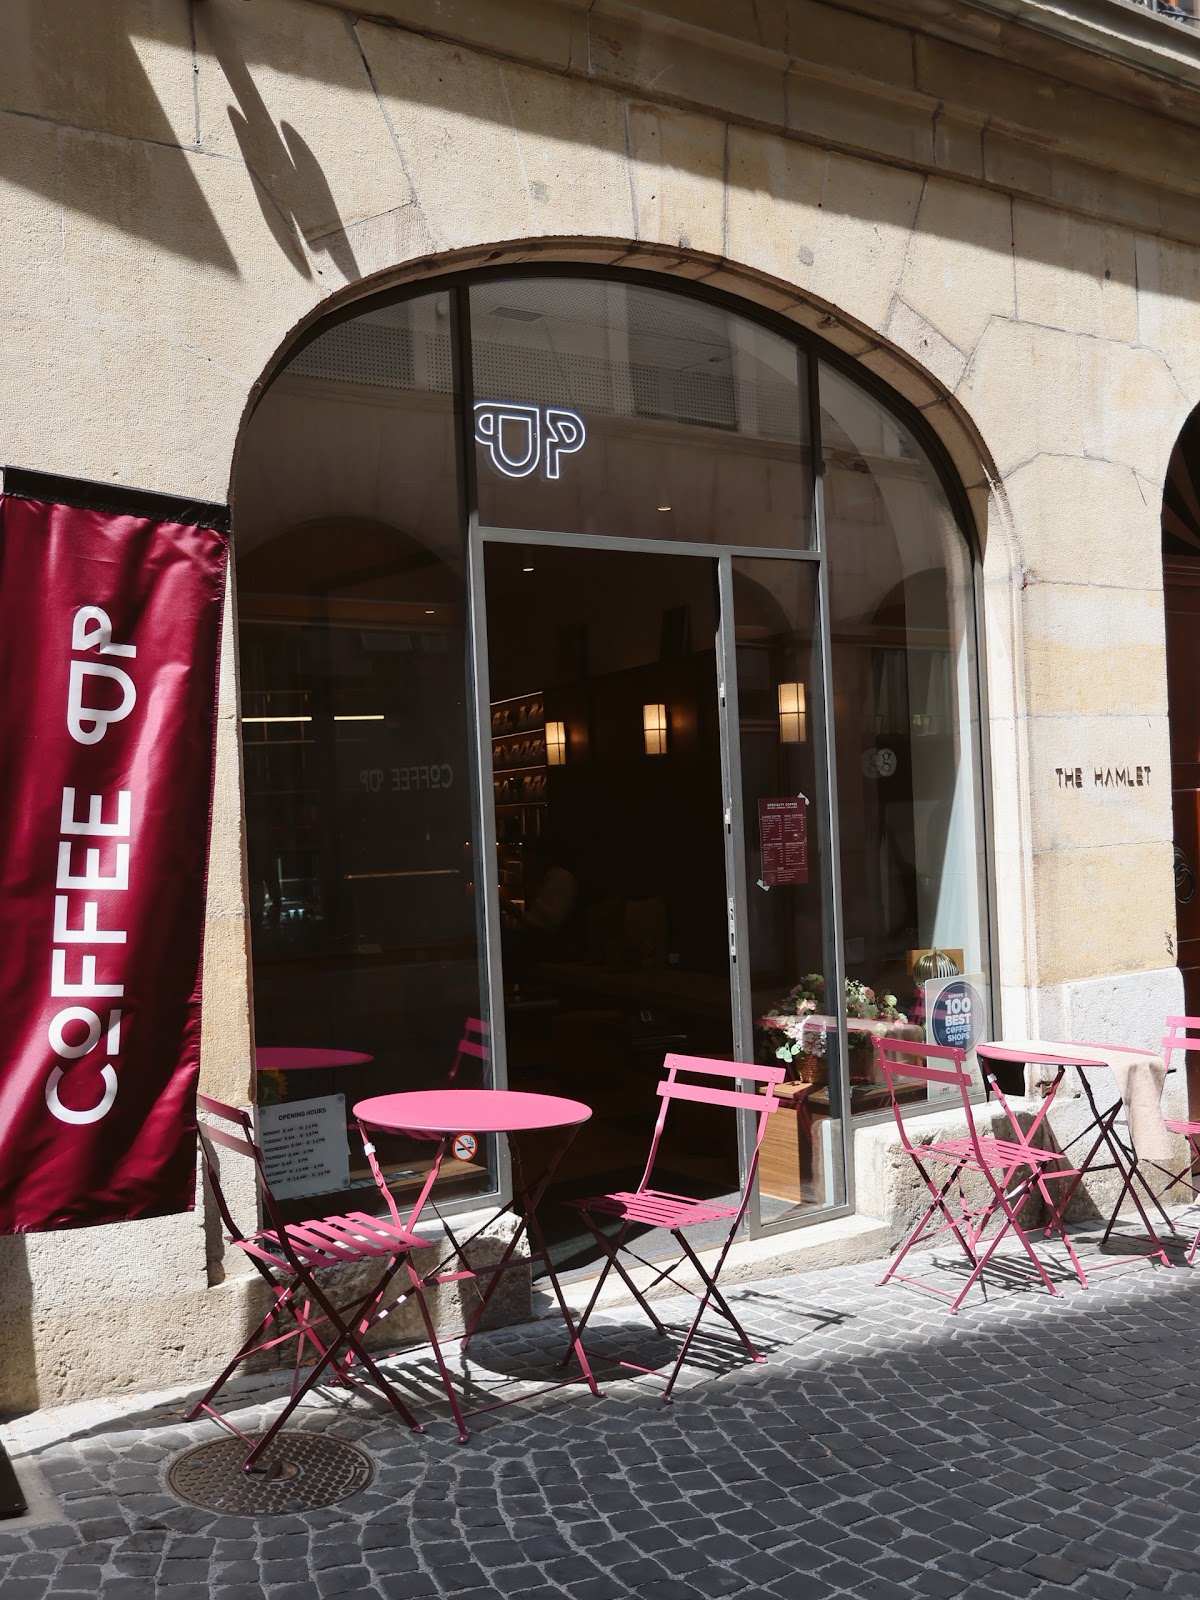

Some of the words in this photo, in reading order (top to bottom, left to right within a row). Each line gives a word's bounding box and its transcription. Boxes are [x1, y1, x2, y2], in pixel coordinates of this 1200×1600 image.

[1055, 767, 1083, 789] THE
[1094, 765, 1151, 788] HAMLET
[45, 786, 132, 1125] COFFEE
[945, 997, 971, 1015] 100
[945, 1013, 972, 1027] BEST
[945, 1024, 972, 1035] COFFEE
[947, 1032, 970, 1042] SHOPS
[279, 1110, 306, 1121] OPENING
[306, 1107, 327, 1117] HOURS
[264, 1144, 290, 1153] WEDNESDAY
[265, 1153, 287, 1161] THURSDAY
[266, 1170, 287, 1178] SATURDAY
